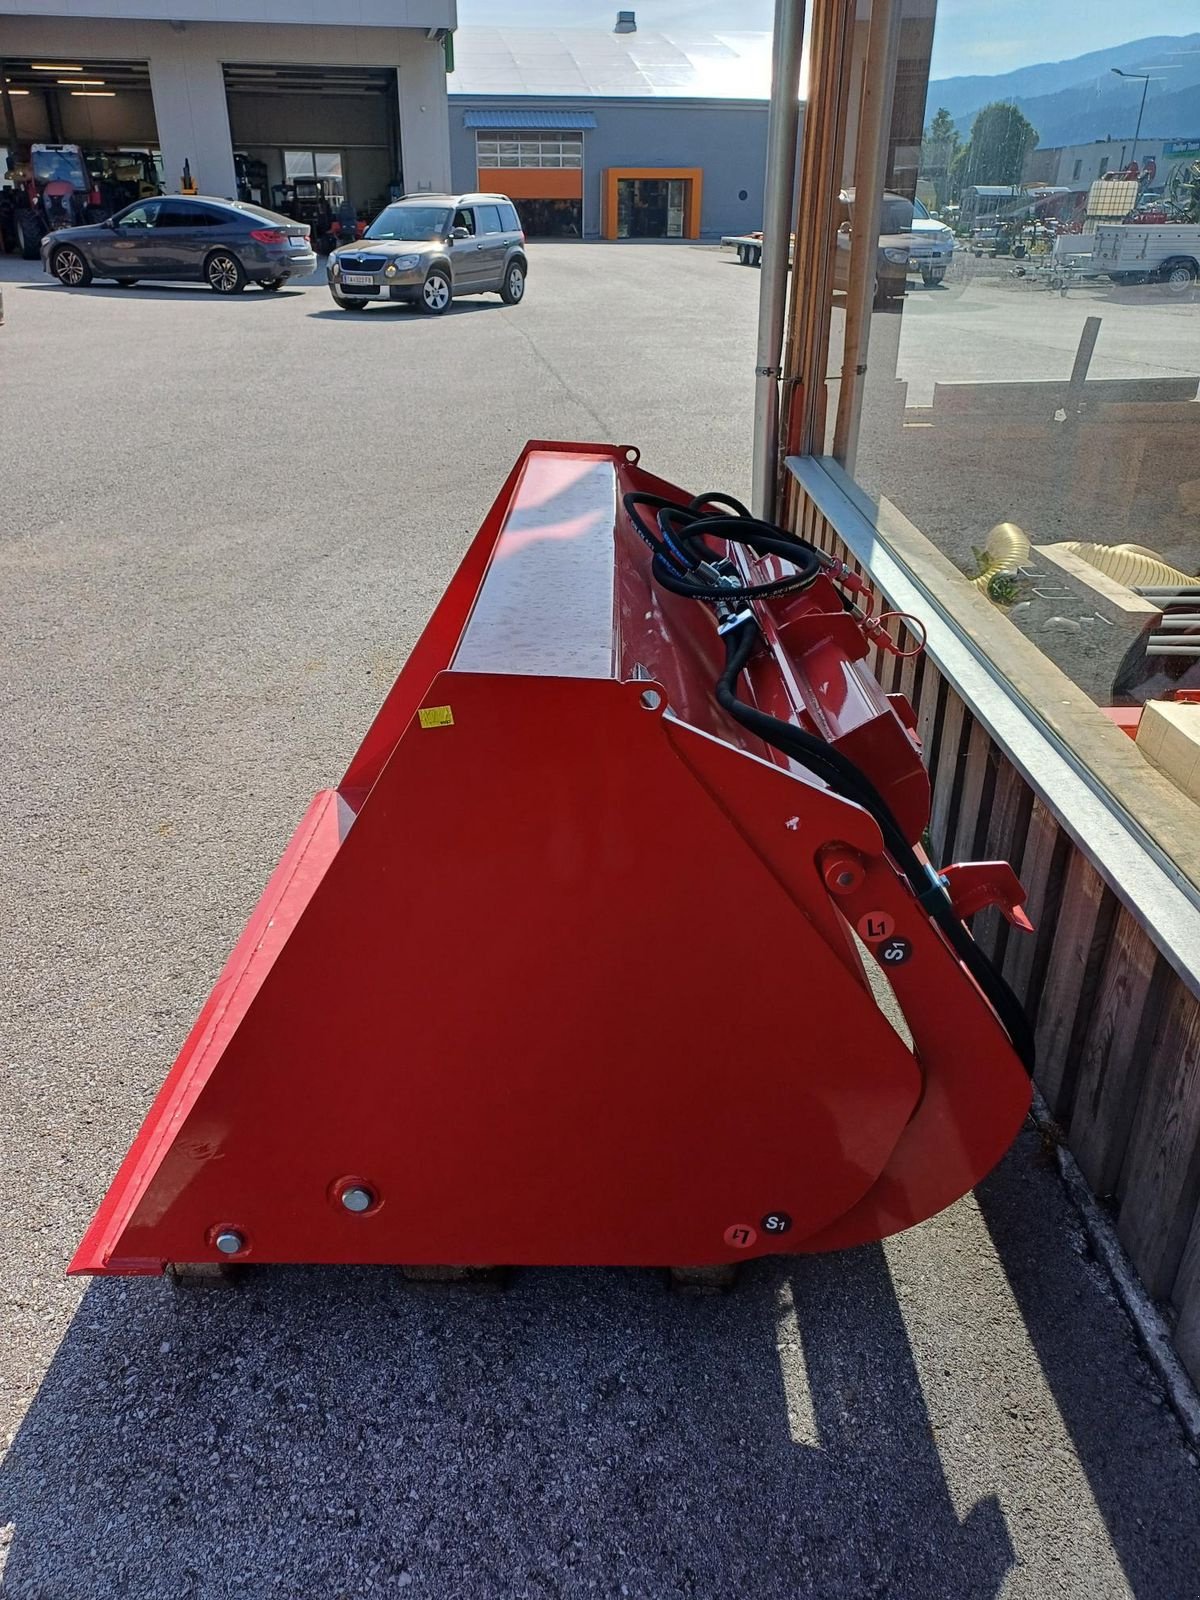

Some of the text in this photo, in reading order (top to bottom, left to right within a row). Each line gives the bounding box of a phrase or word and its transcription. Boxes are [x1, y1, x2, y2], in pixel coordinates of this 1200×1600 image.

[867, 918, 886, 937] L1
[884, 942, 905, 961] S1
[765, 1216, 785, 1231] S1
